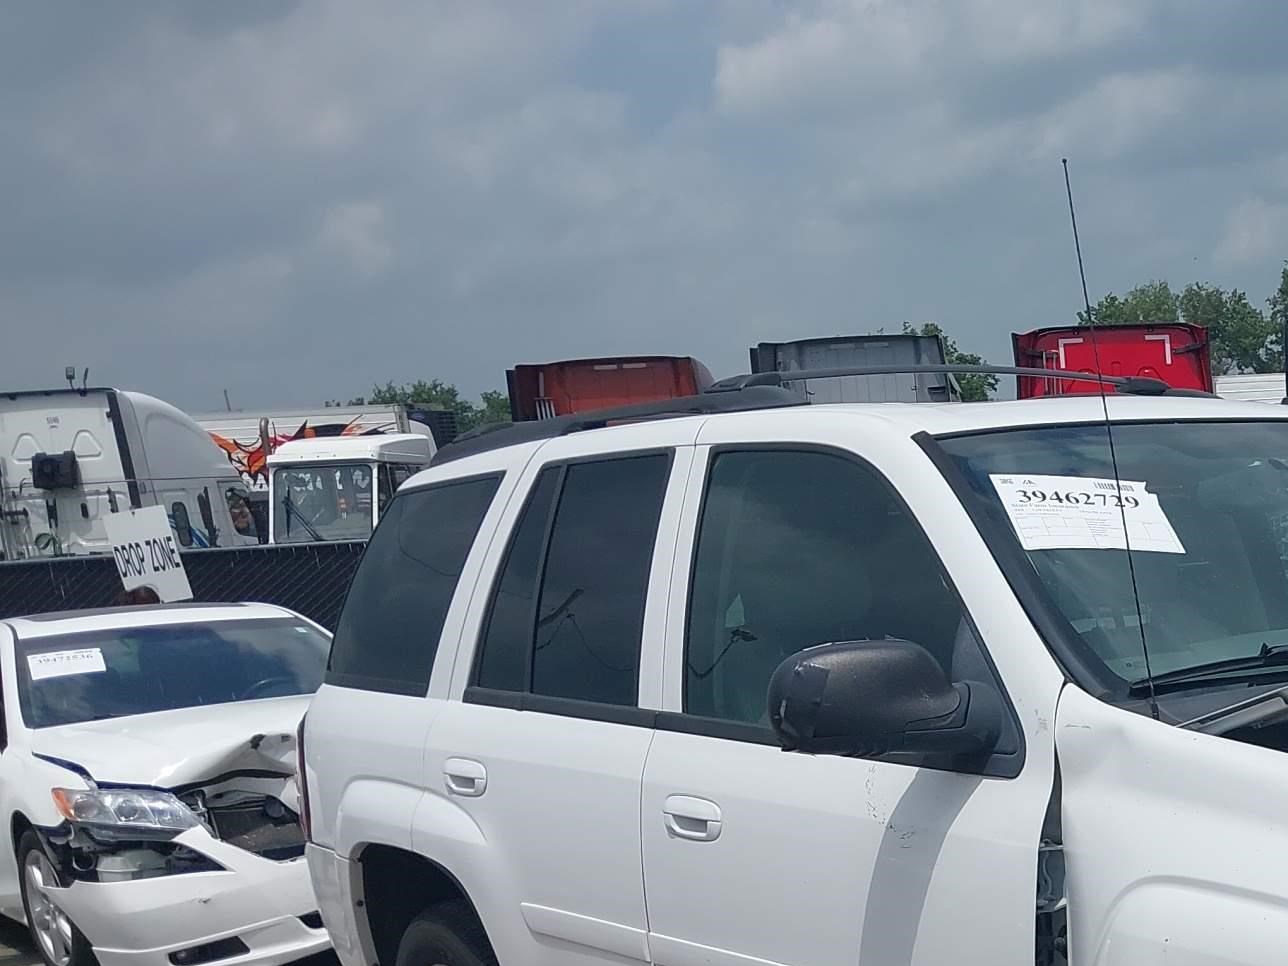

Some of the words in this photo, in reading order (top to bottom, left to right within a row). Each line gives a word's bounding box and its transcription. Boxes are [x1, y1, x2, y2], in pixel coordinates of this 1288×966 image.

[1015, 489, 1140, 509] 39462729
[113, 542, 146, 578] DROP
[144, 535, 181, 572] ZONE
